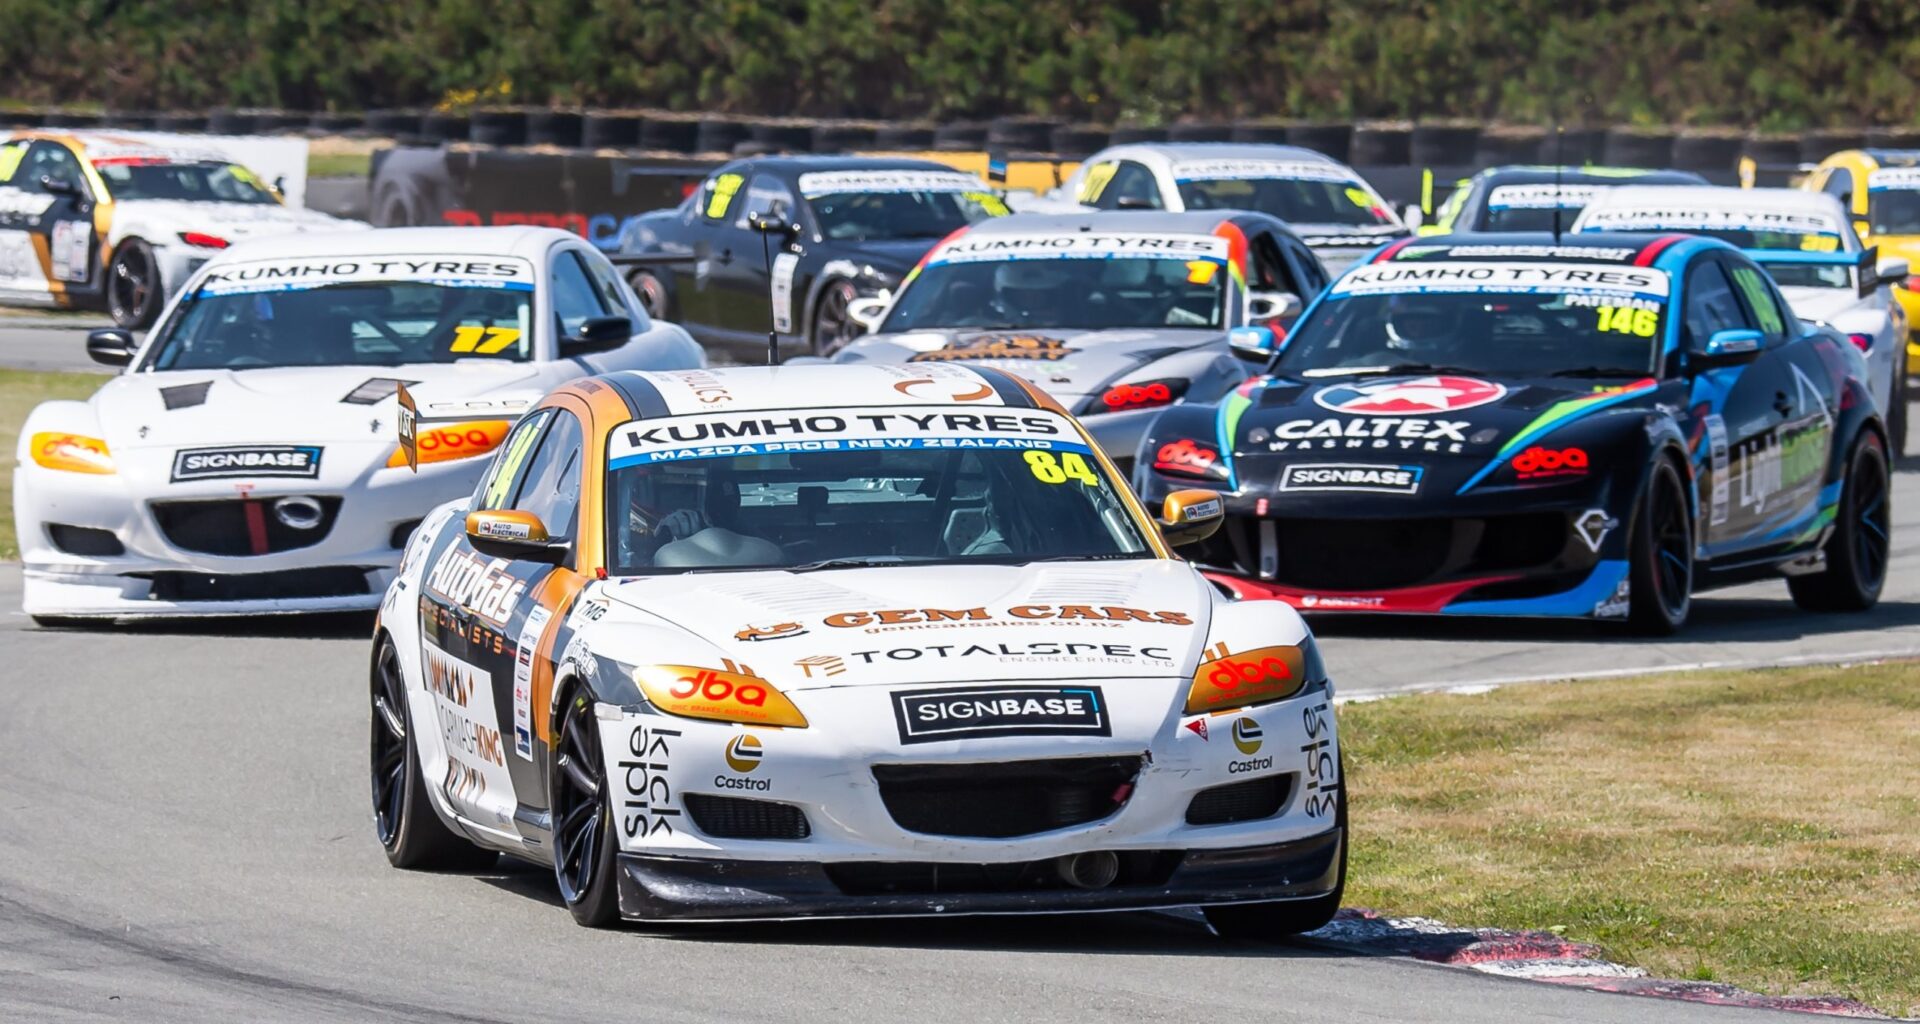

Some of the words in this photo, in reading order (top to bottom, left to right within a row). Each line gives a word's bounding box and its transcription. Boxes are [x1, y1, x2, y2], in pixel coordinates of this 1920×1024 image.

[208, 263, 360, 283] KUMHO
[371, 261, 520, 277] TYRES
[1350, 268, 1495, 284] KUMHO
[1506, 268, 1651, 287] TYRES
[1596, 305, 1659, 338] 146
[450, 327, 521, 354] 17
[418, 429, 490, 451] dba
[626, 416, 847, 448] KUMHO
[856, 413, 1059, 435] TYRES
[1274, 418, 1472, 442] CALTEX
[650, 444, 758, 462] MAZDA
[848, 439, 913, 449] NEW
[922, 438, 1052, 450] ZEALAND
[1269, 439, 1466, 454] WASHDYKE
[186, 453, 308, 470] SIGNBASE
[1022, 449, 1099, 487] 84
[1291, 470, 1413, 486] SIGNBASE
[426, 533, 527, 624] AutoGas
[822, 607, 992, 628] GEM
[1007, 605, 1194, 626] CARS
[851, 642, 1172, 664] TOTALSPEC
[1208, 658, 1293, 691] dba
[670, 670, 767, 707] dba
[918, 699, 1085, 721] SIGNBASE
[1229, 756, 1273, 774] Castrol
[714, 775, 771, 791] Castrol
